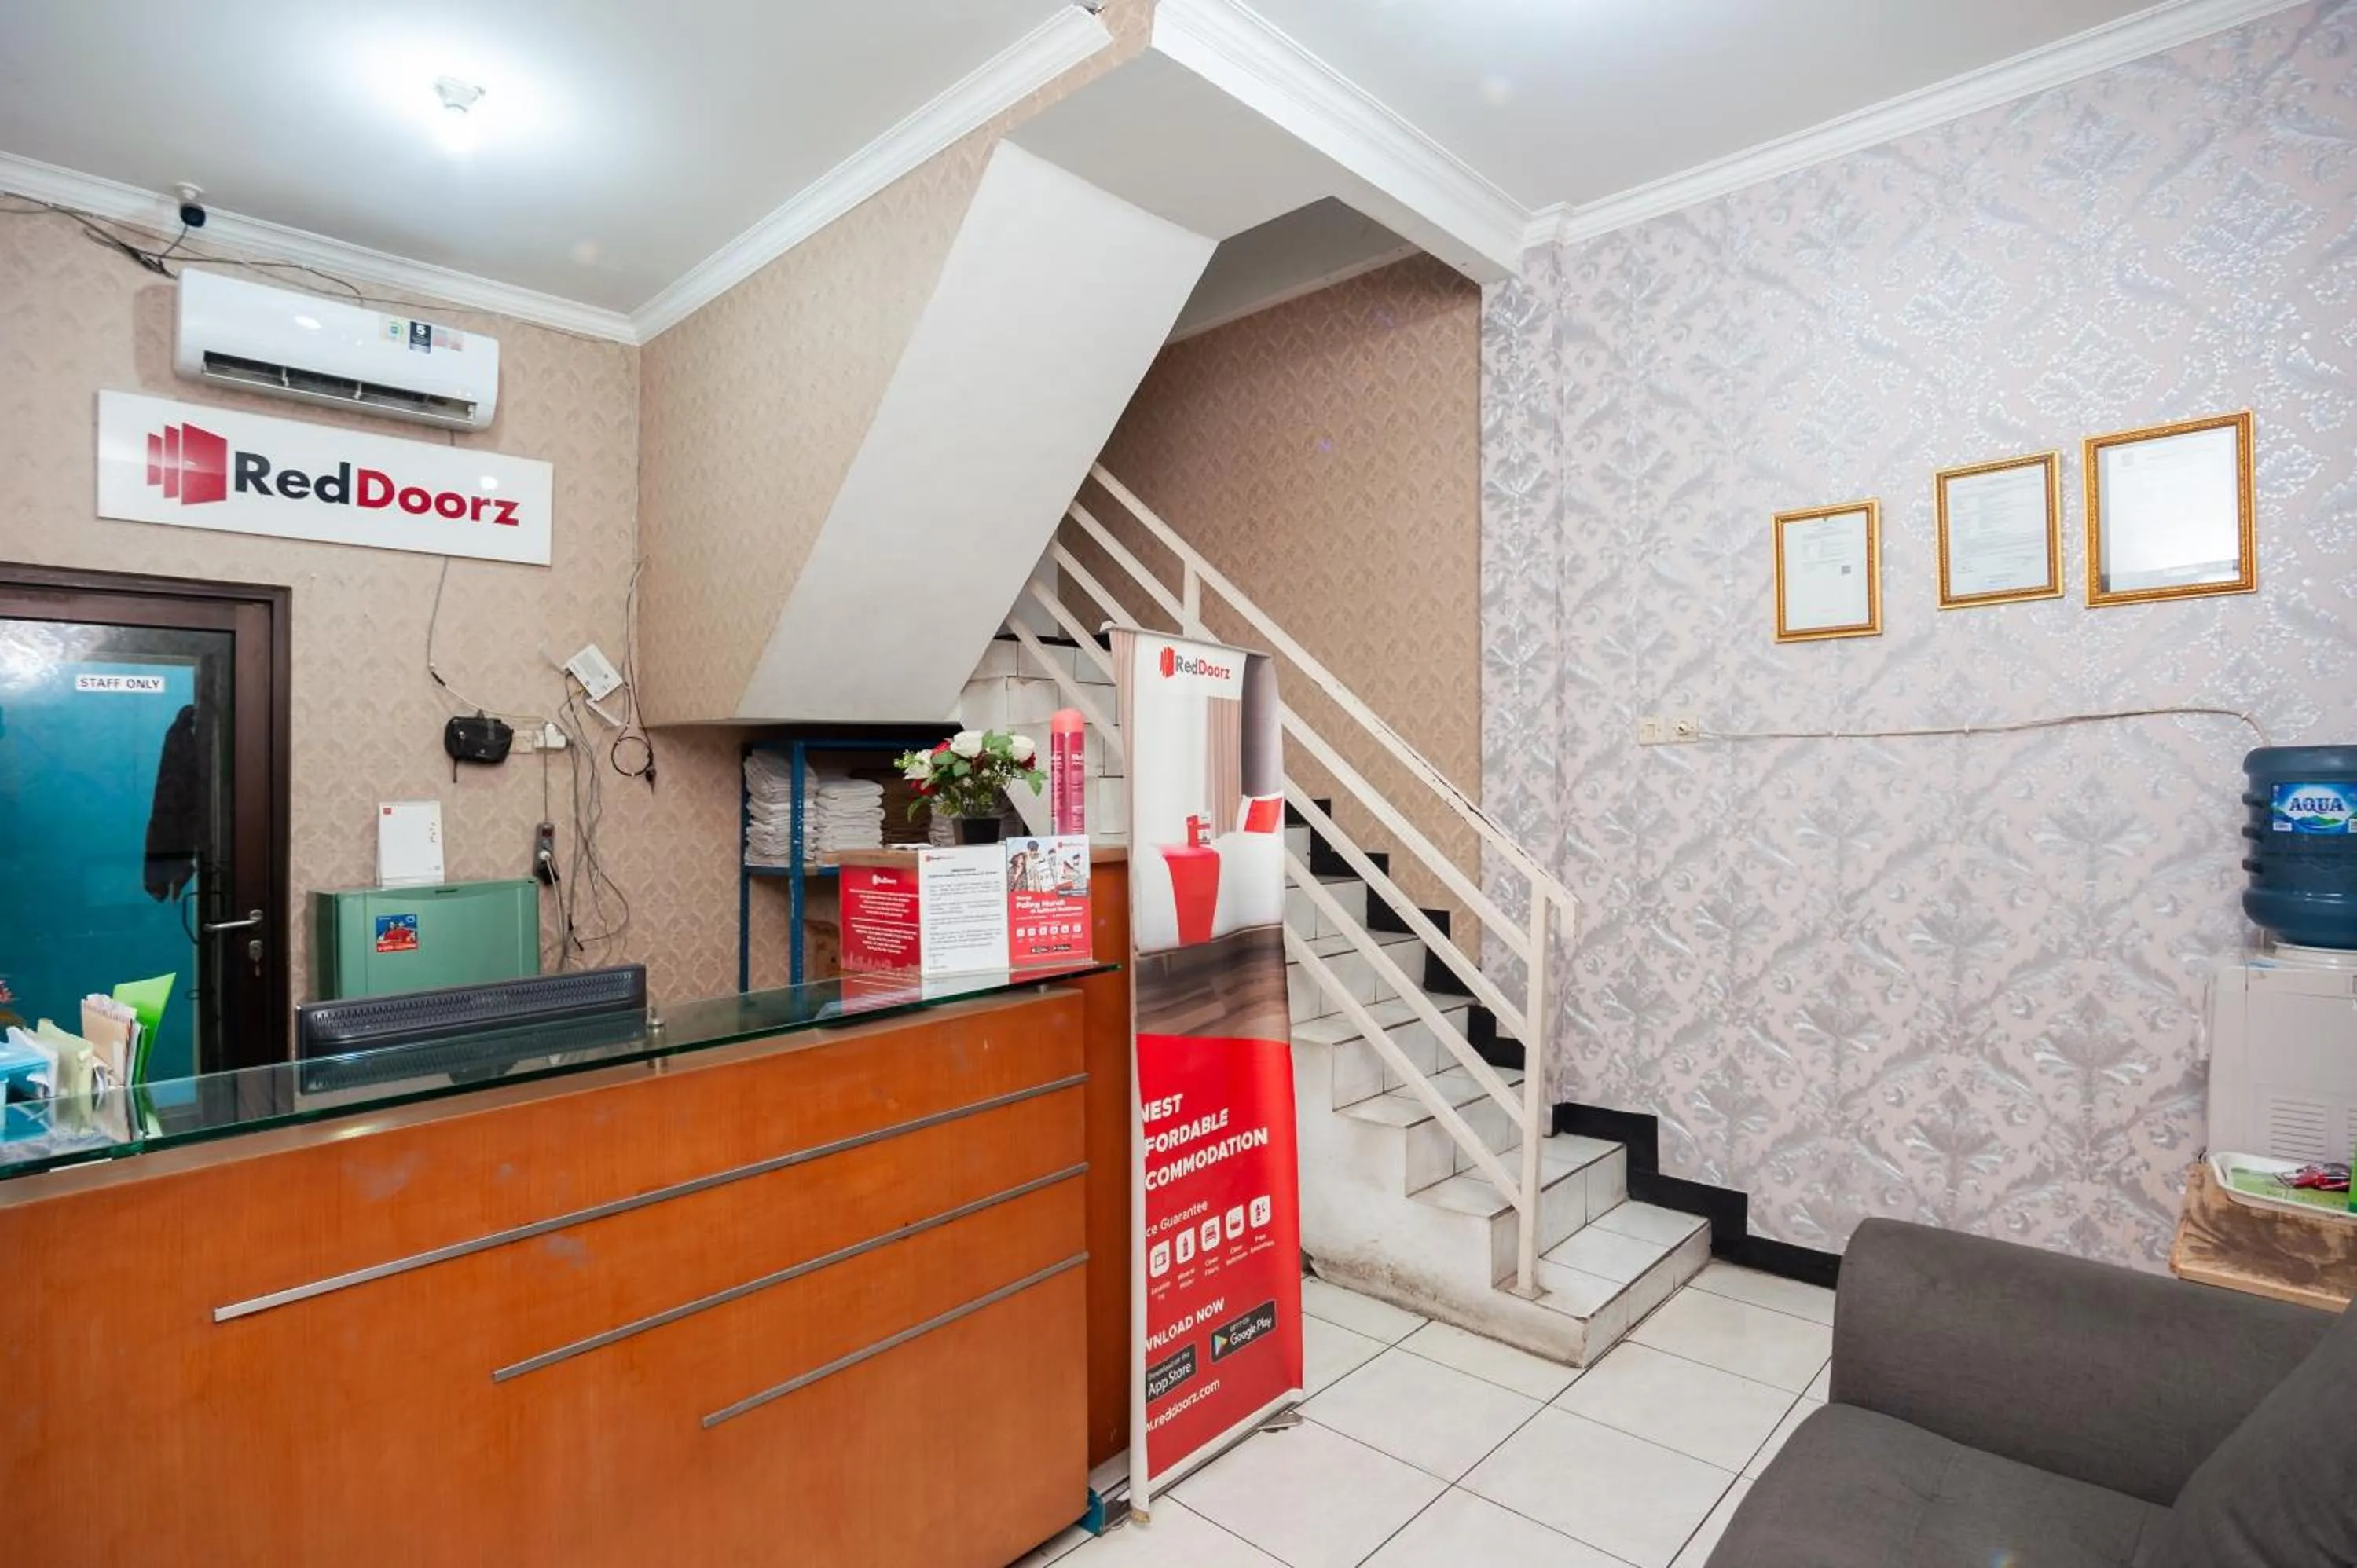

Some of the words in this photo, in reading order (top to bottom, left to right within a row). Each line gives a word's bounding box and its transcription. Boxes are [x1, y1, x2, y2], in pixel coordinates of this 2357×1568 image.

[234, 450, 520, 526] RedDoorz
[1175, 654, 1230, 680] RedDoorz
[80, 678, 120, 688] STAFF
[126, 678, 160, 689] ONLY
[2289, 797, 2345, 814] AQUA
[1145, 1127, 1268, 1191] COMMODATION
[1160, 1200, 1208, 1231] Guarantee
[1197, 1298, 1225, 1324] NOW
[1230, 1325, 1256, 1346] Google
[1257, 1316, 1272, 1331] Play
[1148, 1378, 1168, 1398] App
[1168, 1363, 1192, 1385] Store
